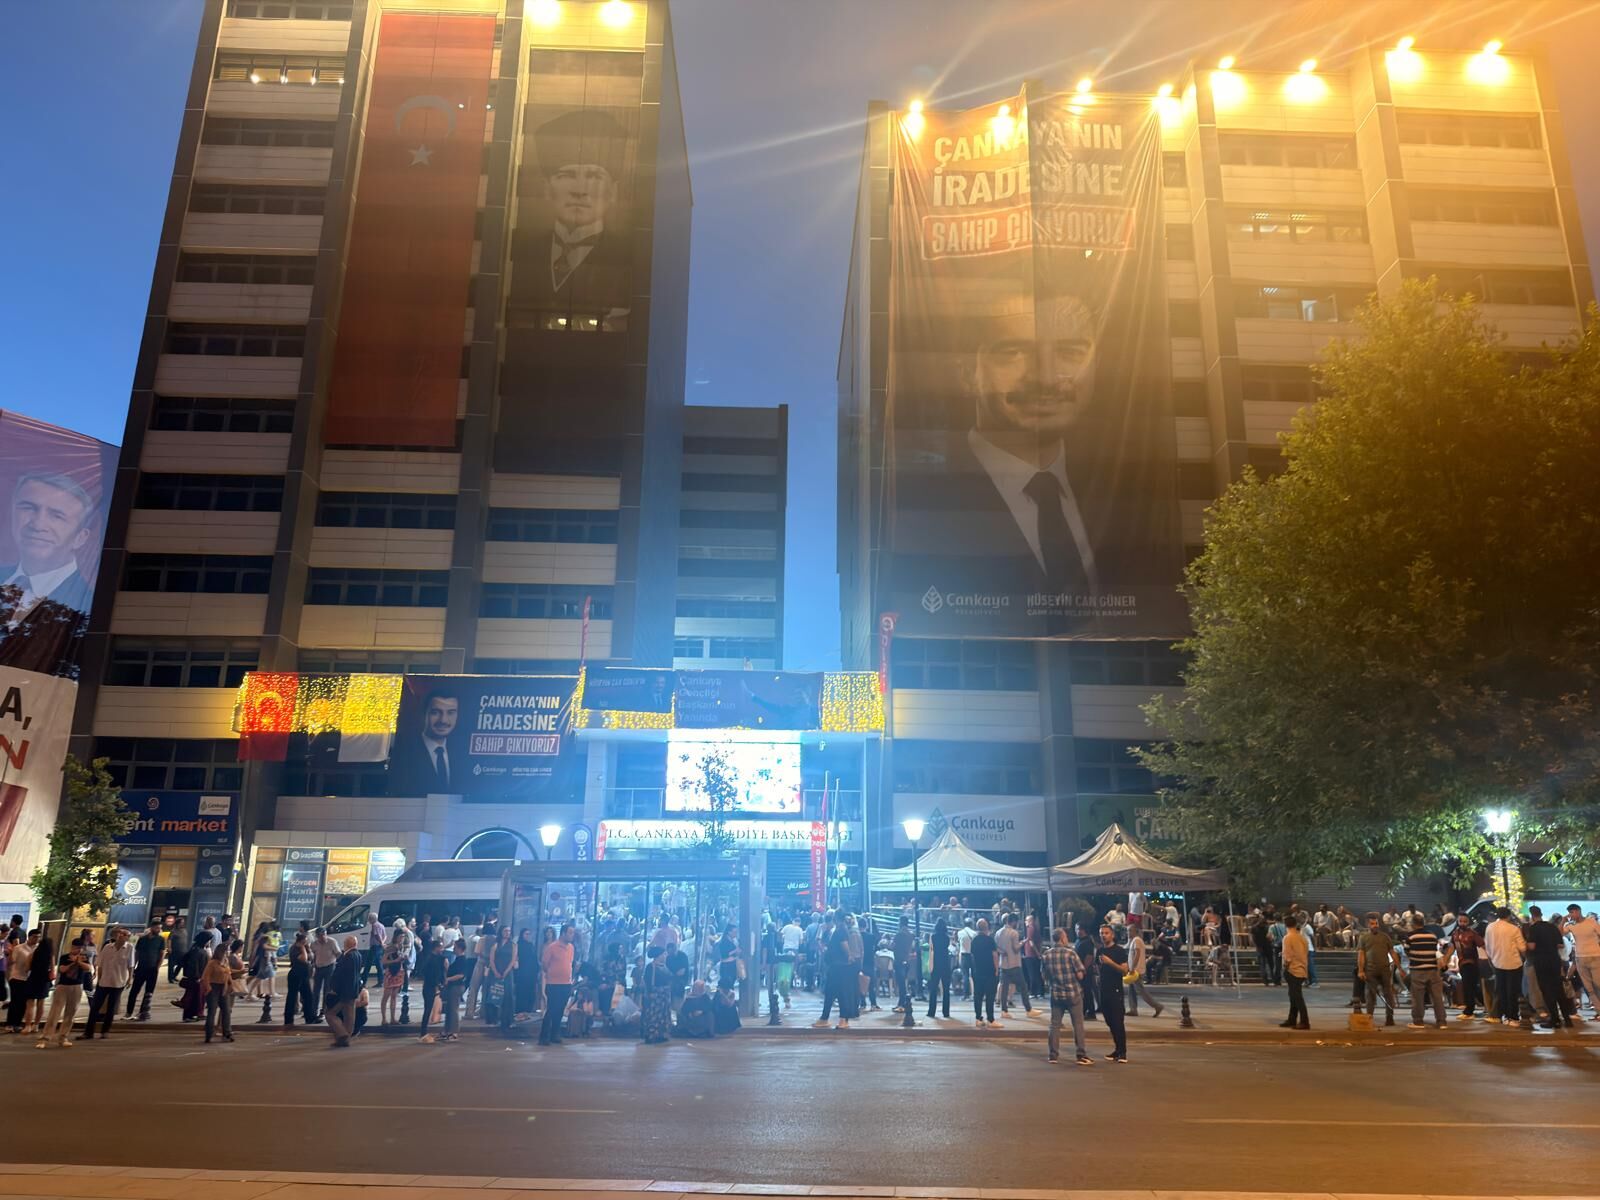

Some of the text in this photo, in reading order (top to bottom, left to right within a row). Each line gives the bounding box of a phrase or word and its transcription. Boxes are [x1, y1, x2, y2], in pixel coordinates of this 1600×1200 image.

[480, 695, 560, 709] ÇANKAYA'NIN
[477, 709, 559, 731] İRADESİNE
[475, 736, 555, 753] SAHİP ÇIKIYORUZ
[160, 819, 228, 833] market
[951, 815, 1015, 832] Çankaya
[634, 828, 698, 842] ÇANKAYA
